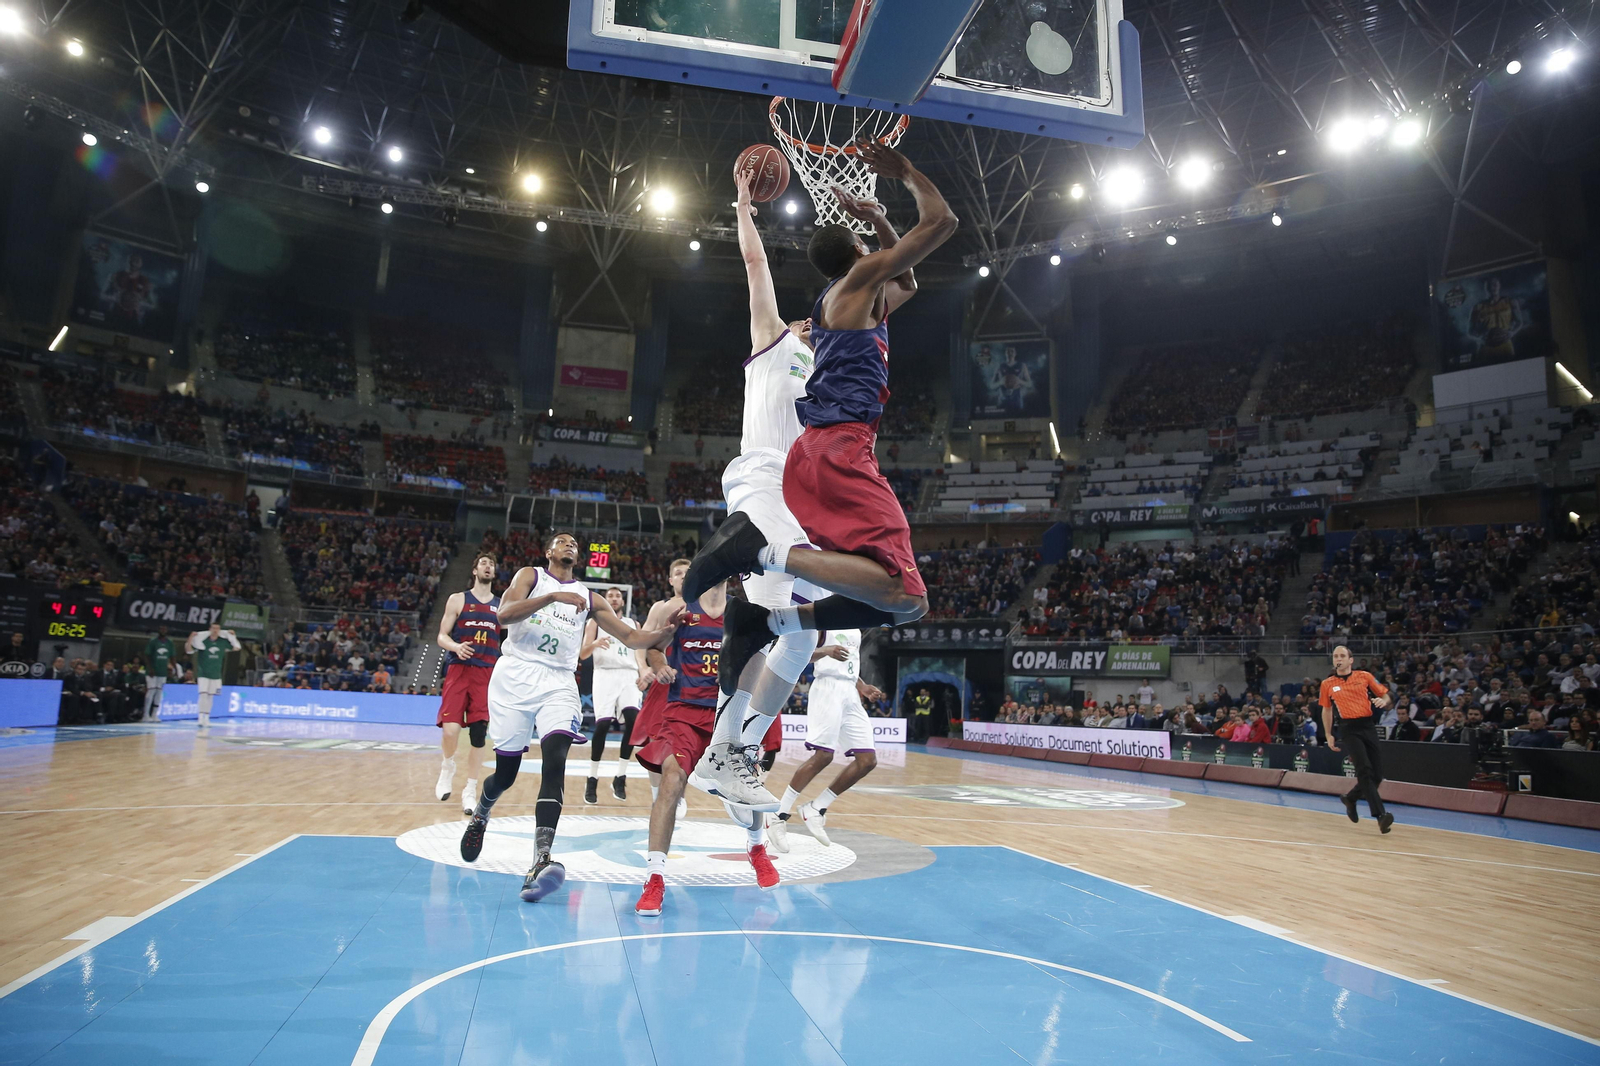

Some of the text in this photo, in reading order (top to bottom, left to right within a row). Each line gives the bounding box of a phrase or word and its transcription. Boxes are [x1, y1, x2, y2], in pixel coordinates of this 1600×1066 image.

[553, 428, 581, 440] COPA
[588, 431, 608, 442] REY
[1129, 509, 1153, 522] REY
[1219, 501, 1319, 515] movistar CaixaBank
[589, 552, 609, 567] 20
[52, 602, 103, 618] 4 1 4
[129, 600, 176, 621] COPA
[187, 606, 221, 624] REY
[48, 622, 87, 637] 06:25
[474, 630, 488, 645] 44
[537, 633, 560, 655] 23
[618, 647, 628, 656] 44
[1114, 650, 1152, 660] 4 DÍAS DE
[701, 654, 719, 674] 33
[848, 661, 854, 674] 8
[1012, 651, 1106, 670] COPA DEL REY
[1111, 662, 1160, 670] ADRENALINA
[5, 664, 25, 673] KIA
[243, 701, 269, 714] the
[271, 702, 311, 716] travel
[313, 703, 358, 718] brand
[964, 729, 1164, 758] Document Solutions Document Solutions
